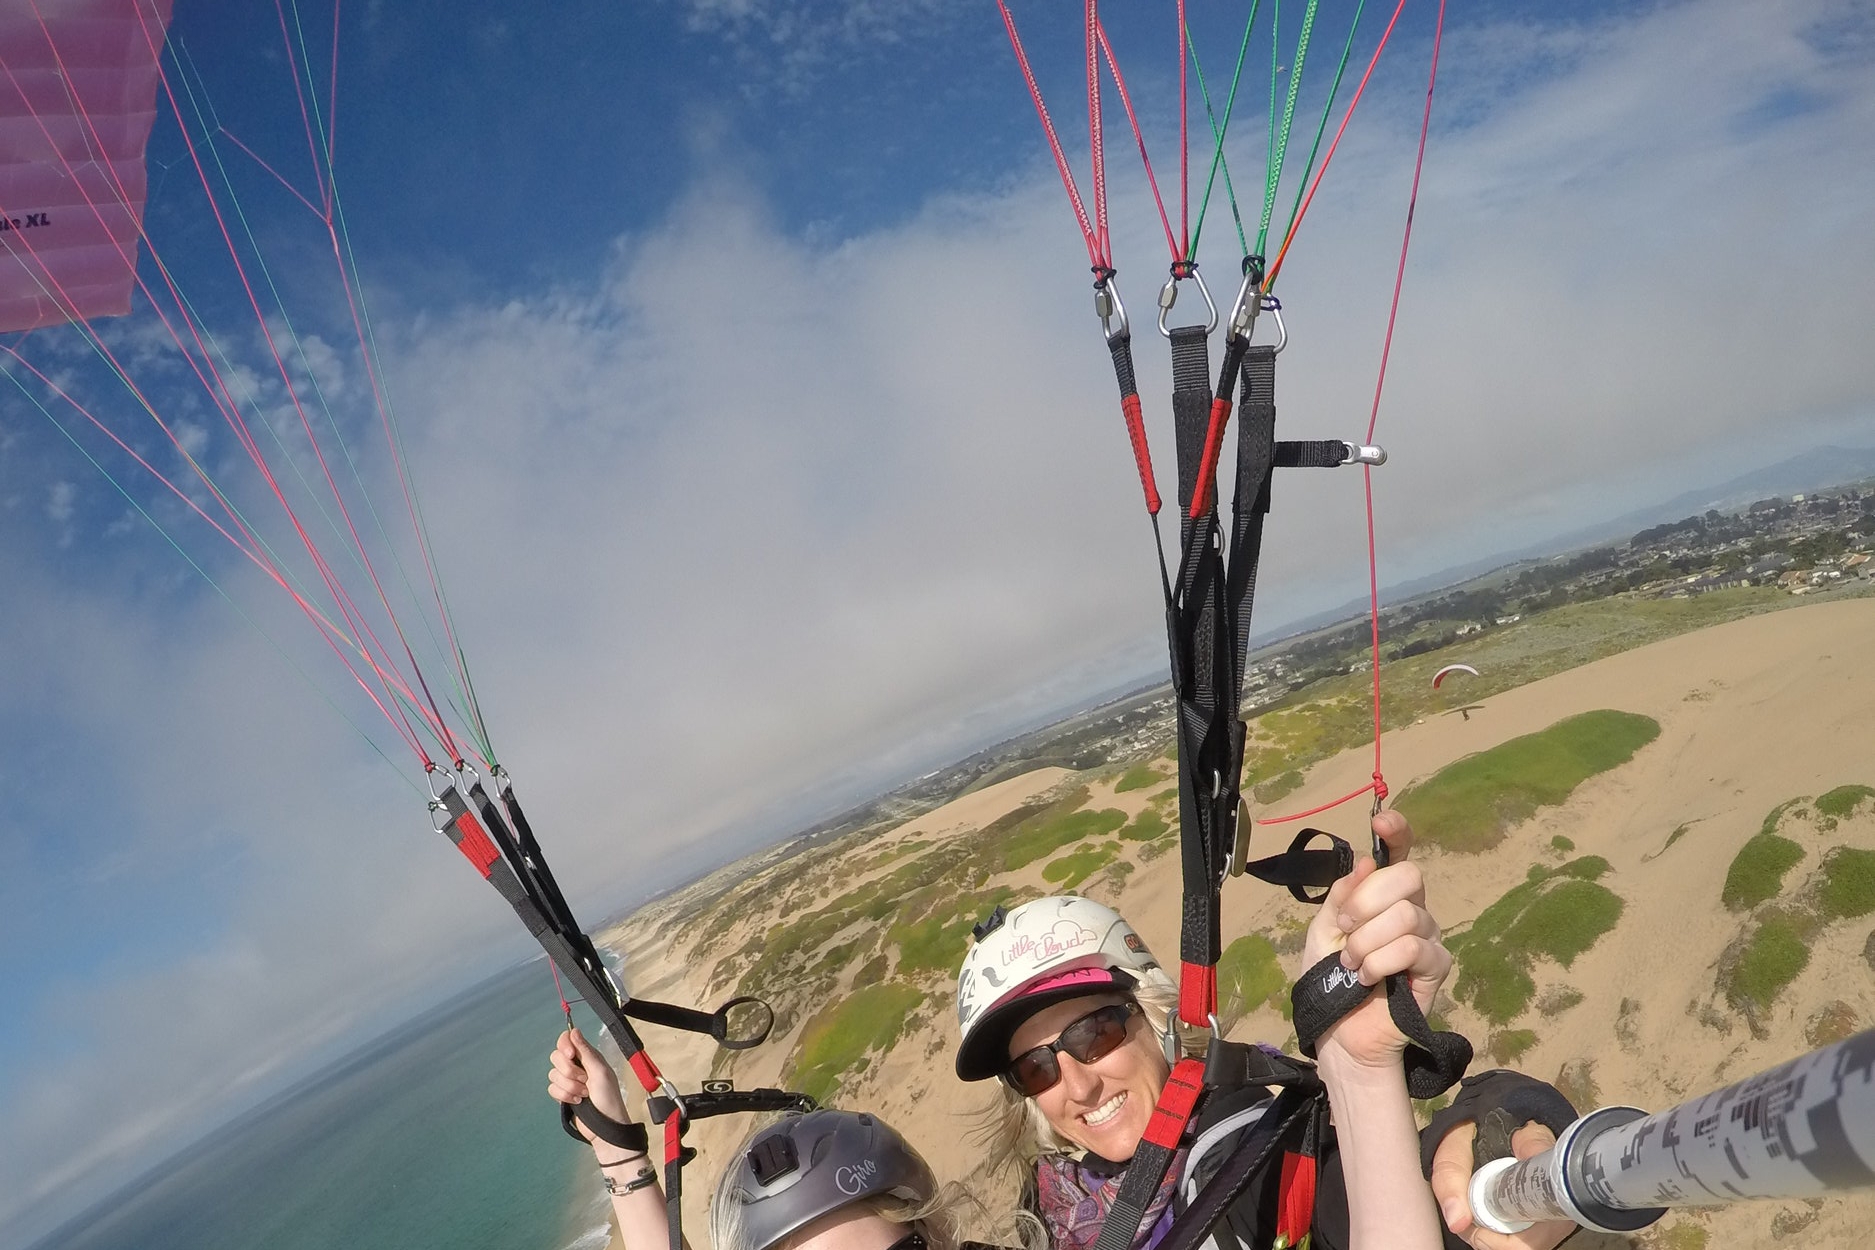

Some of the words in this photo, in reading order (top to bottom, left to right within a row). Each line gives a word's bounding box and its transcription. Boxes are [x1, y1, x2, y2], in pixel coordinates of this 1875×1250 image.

[26, 213, 51, 228] XL
[1001, 934, 1036, 966] Little
[1034, 931, 1084, 961] Cloud
[1322, 966, 1344, 993] Little
[1342, 968, 1359, 989] Clo
[835, 1159, 877, 1195] Giro
